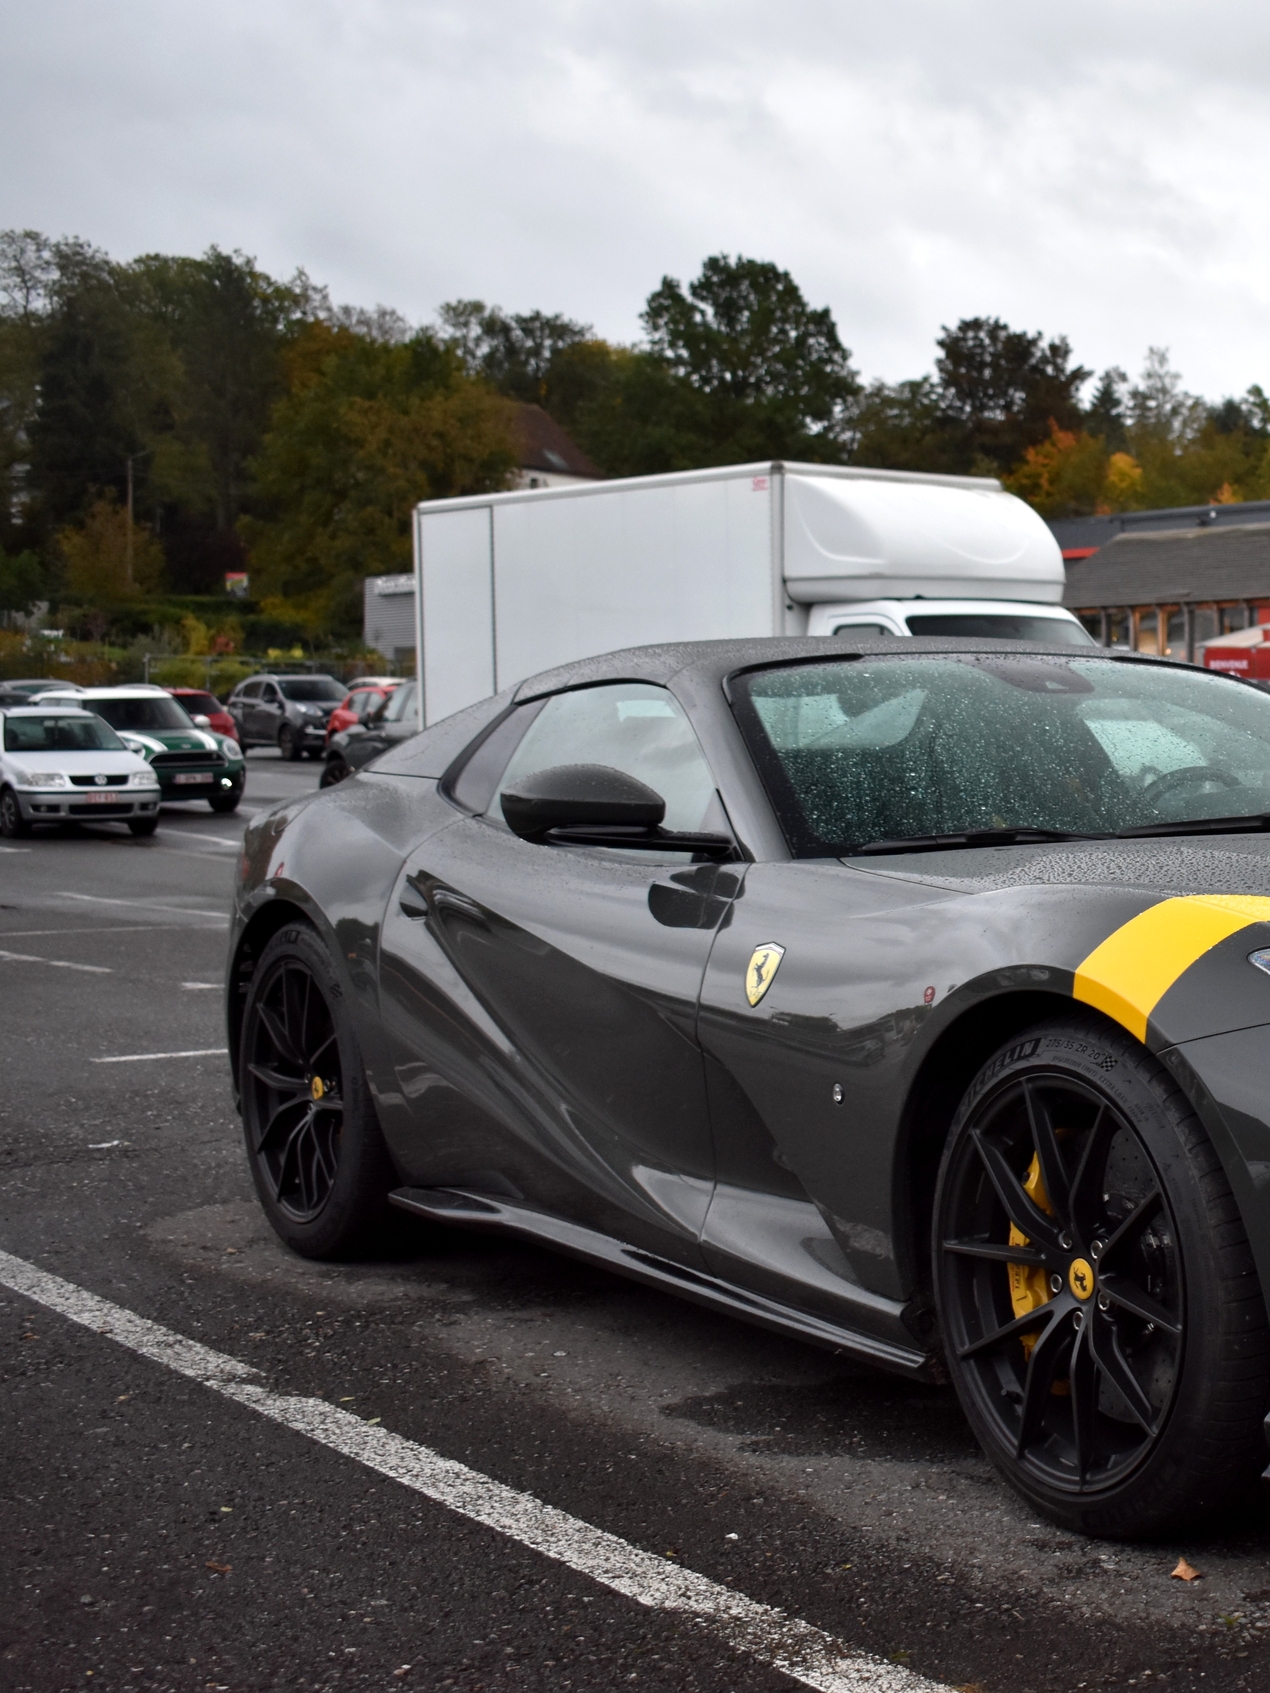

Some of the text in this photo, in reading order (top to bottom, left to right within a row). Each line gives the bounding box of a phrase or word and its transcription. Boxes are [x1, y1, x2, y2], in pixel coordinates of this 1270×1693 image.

[1046, 1038, 1101, 1060] 275/35 ZR 20
